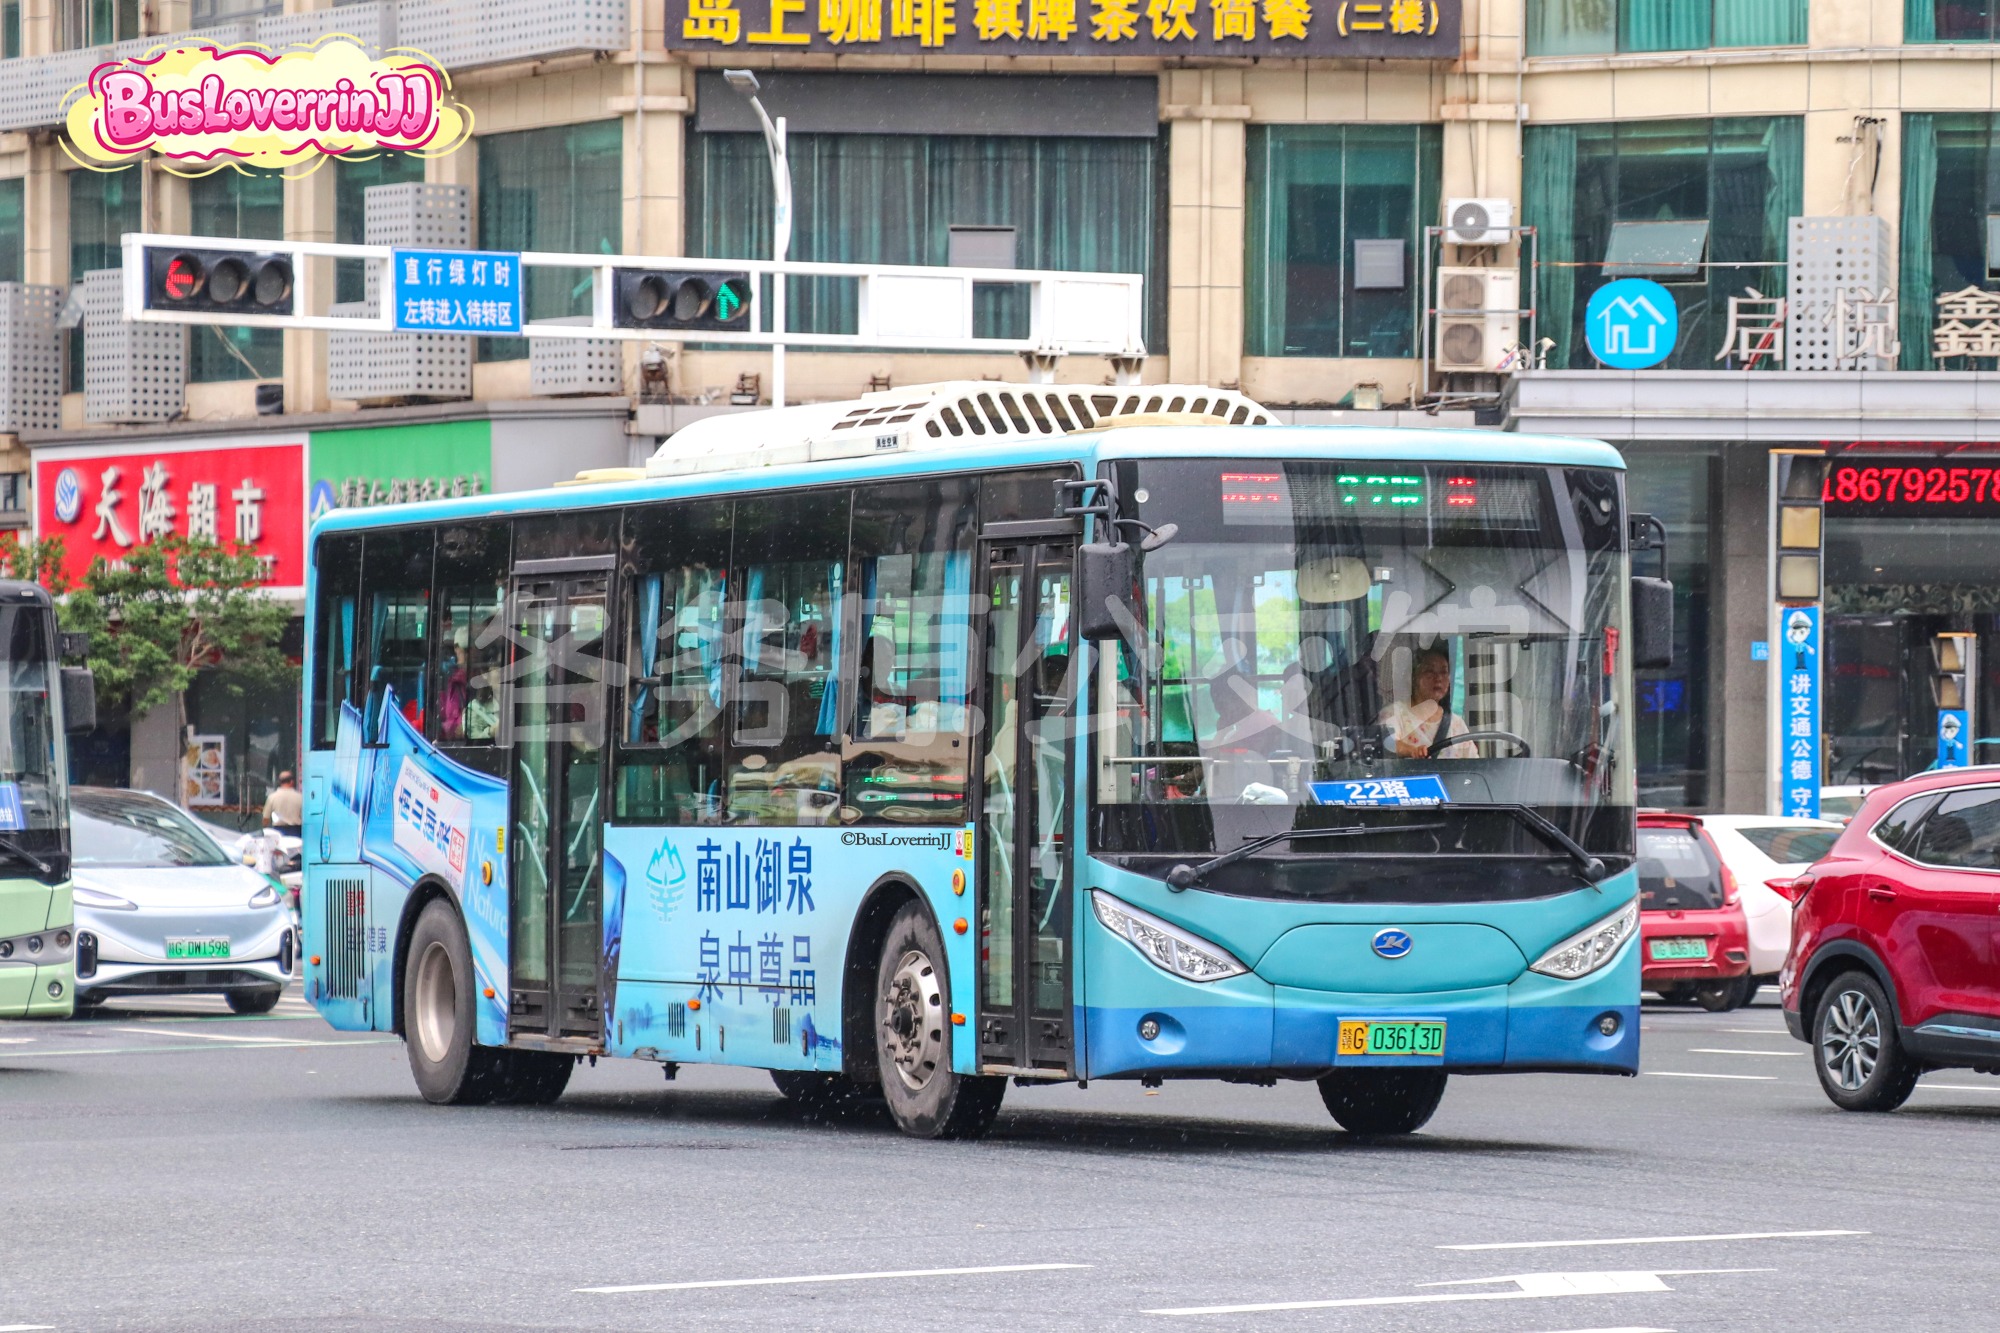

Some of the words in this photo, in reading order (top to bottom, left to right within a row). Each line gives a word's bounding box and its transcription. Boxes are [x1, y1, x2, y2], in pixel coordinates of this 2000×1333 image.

[681, 0, 957, 47] 岛上咖啡
[972, 0, 1314, 42] 棋牌茶饮简餐
[404, 257, 510, 287] 直行绿灯时
[404, 298, 513, 326] 左转进入待转区
[92, 460, 266, 547] 天海超市
[1790, 674, 1812, 780] 讲交通公德
[1345, 780, 1410, 799] 22路
[696, 836, 815, 915] 南山御泉
[696, 930, 816, 1006] 泉中尊品
[1373, 1027, 1442, 1050] 03613D
